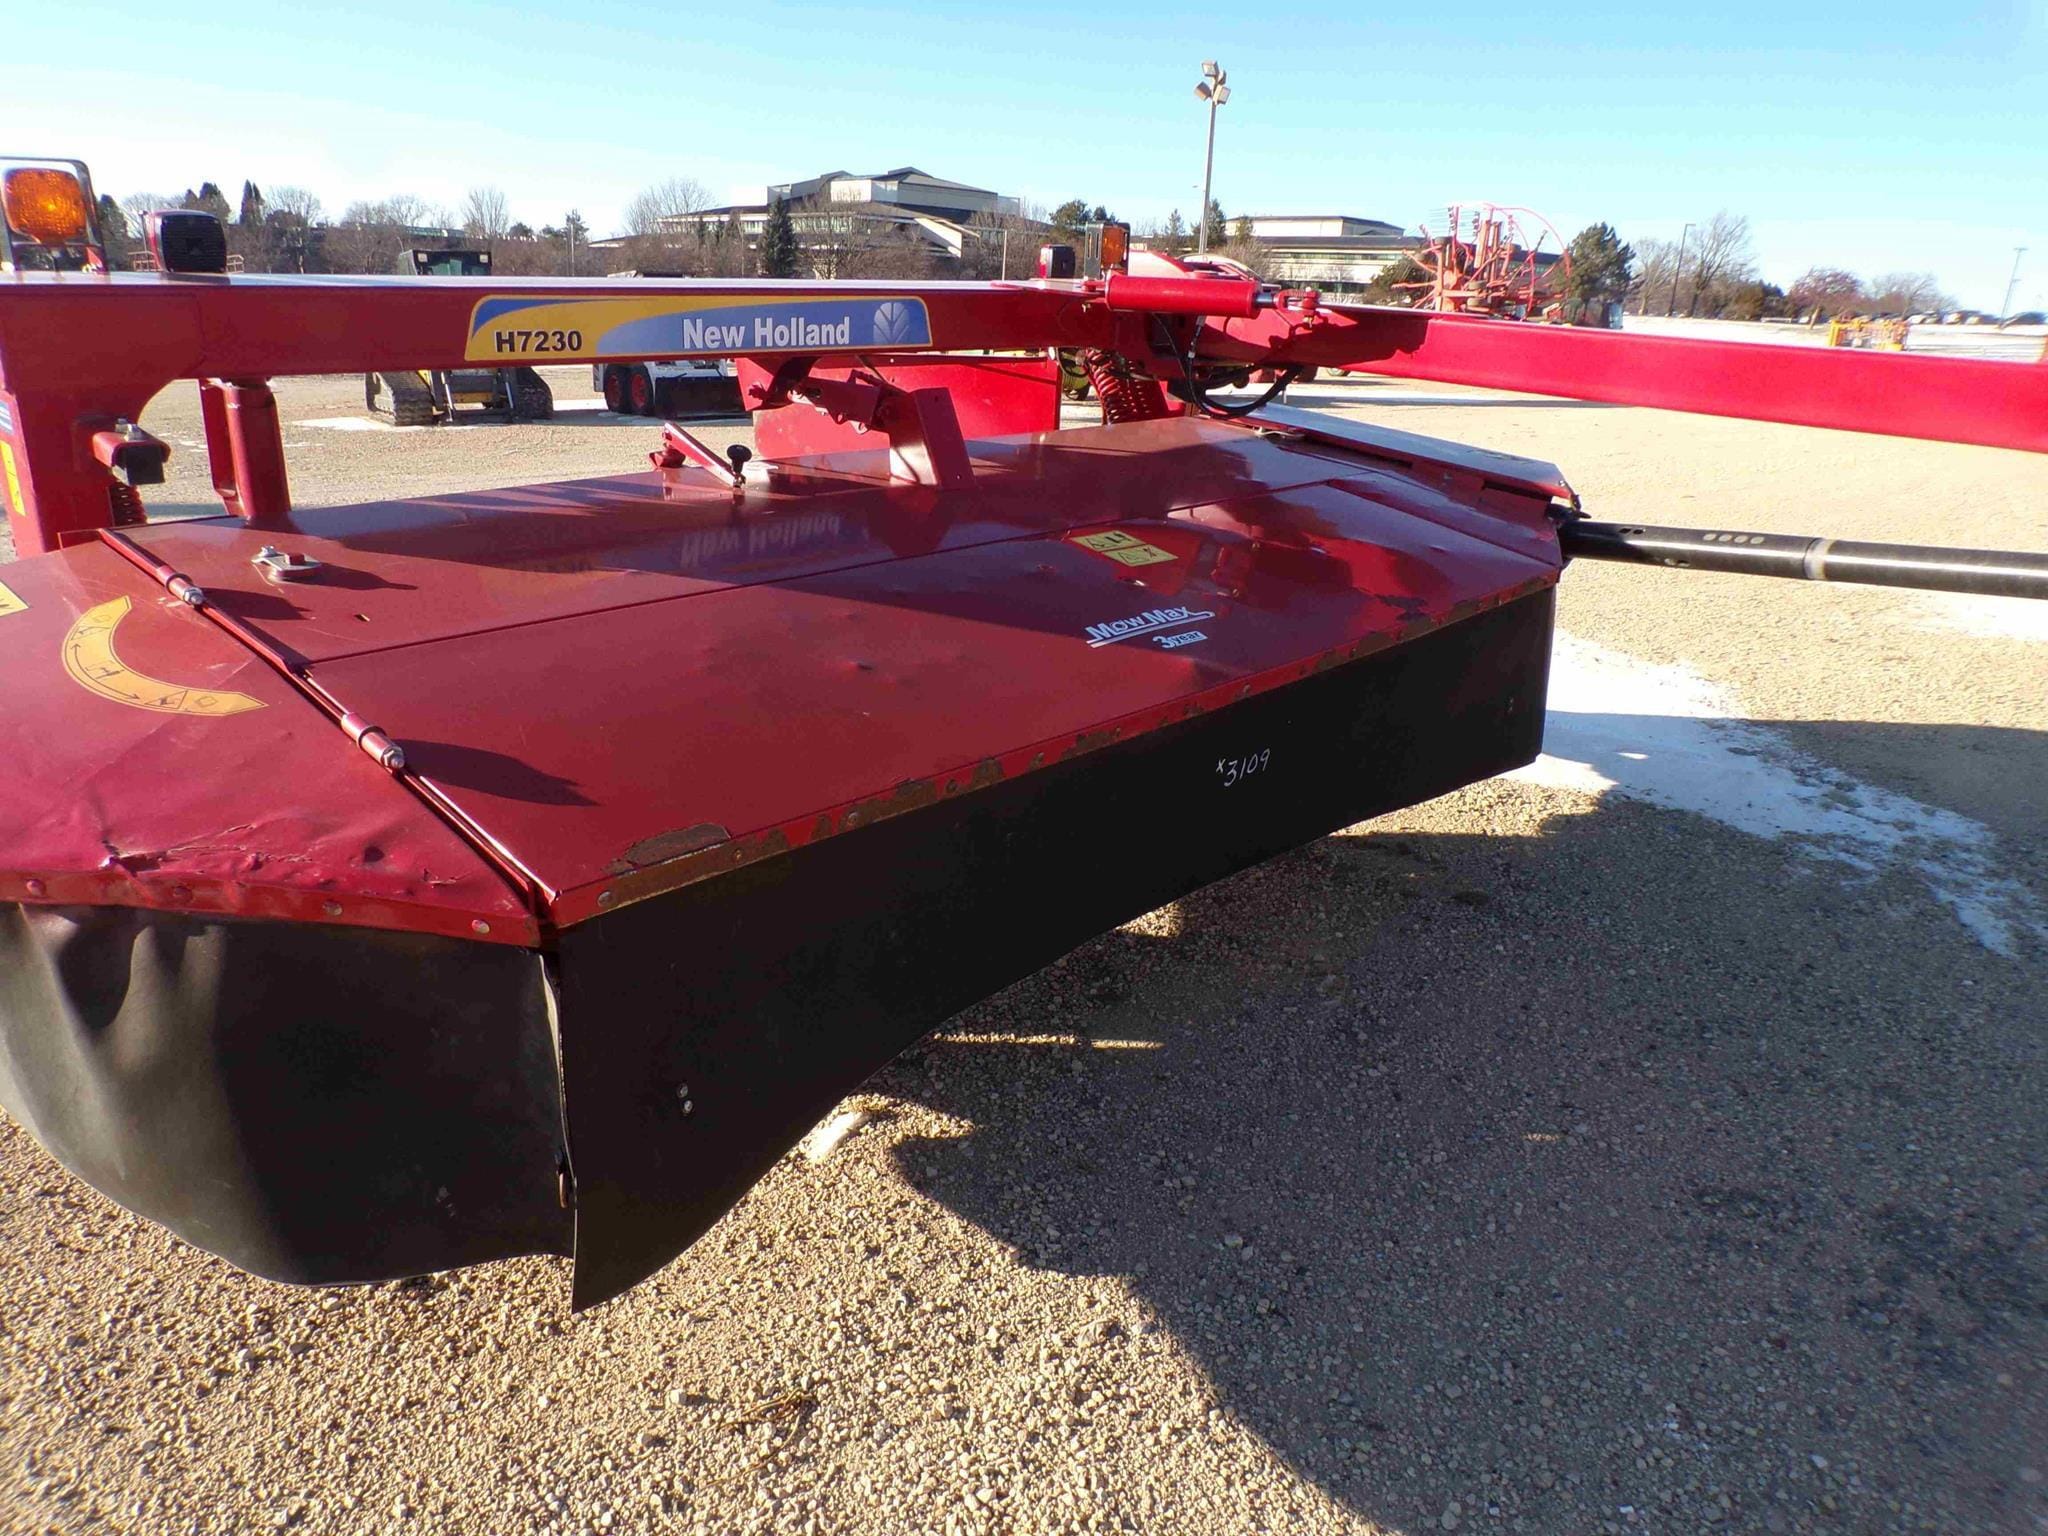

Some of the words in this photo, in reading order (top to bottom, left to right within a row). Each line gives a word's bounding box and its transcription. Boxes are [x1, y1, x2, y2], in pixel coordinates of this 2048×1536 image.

[494, 329, 583, 353] H7230
[683, 318, 746, 349] New
[754, 316, 851, 348] Holland
[1085, 616, 1147, 640] Mow
[1141, 606, 1190, 626] Max
